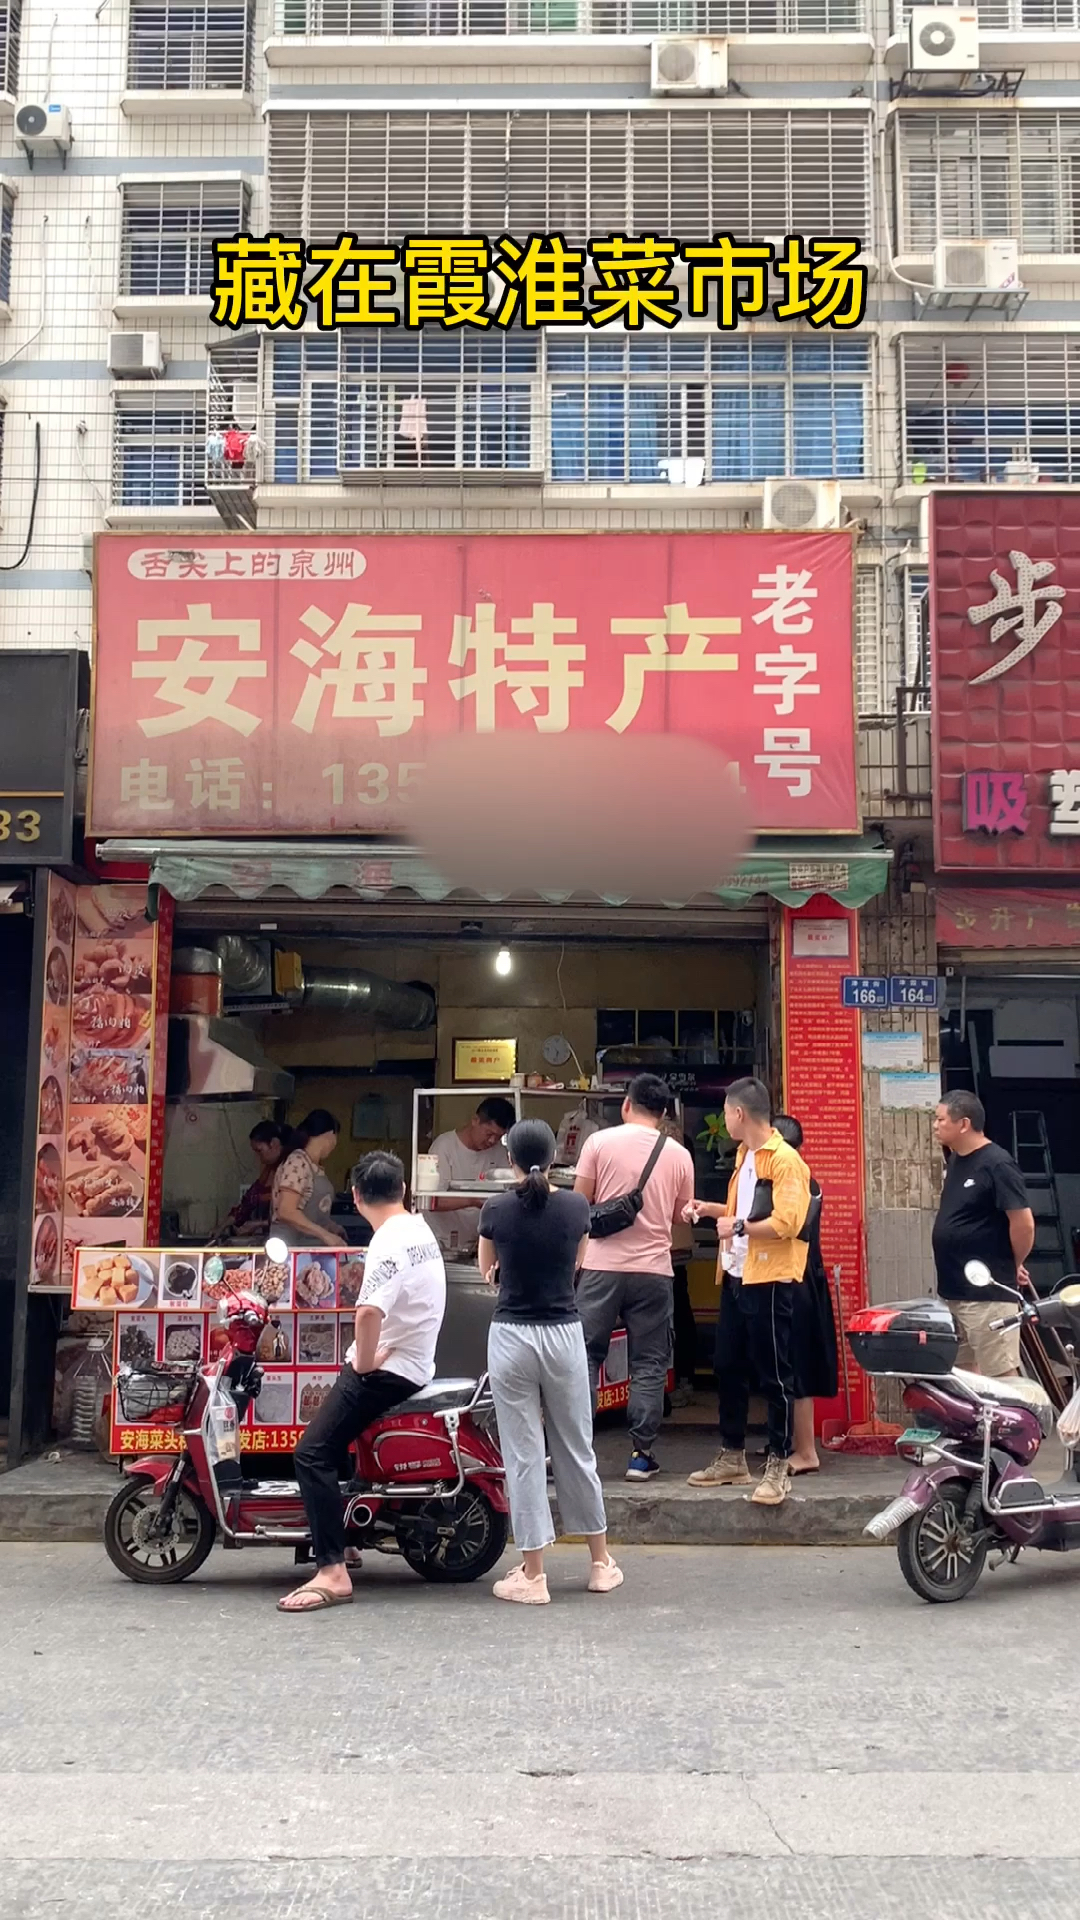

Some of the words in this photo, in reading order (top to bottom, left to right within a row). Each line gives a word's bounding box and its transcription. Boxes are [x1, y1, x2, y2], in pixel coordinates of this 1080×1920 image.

[140, 549, 355, 580] 舌尖上的泉州
[131, 602, 742, 738] 安海特产
[752, 564, 820, 797] 老字号
[322, 762, 428, 806] 135
[853, 988, 877, 1003] 166
[900, 988, 924, 1002] 164
